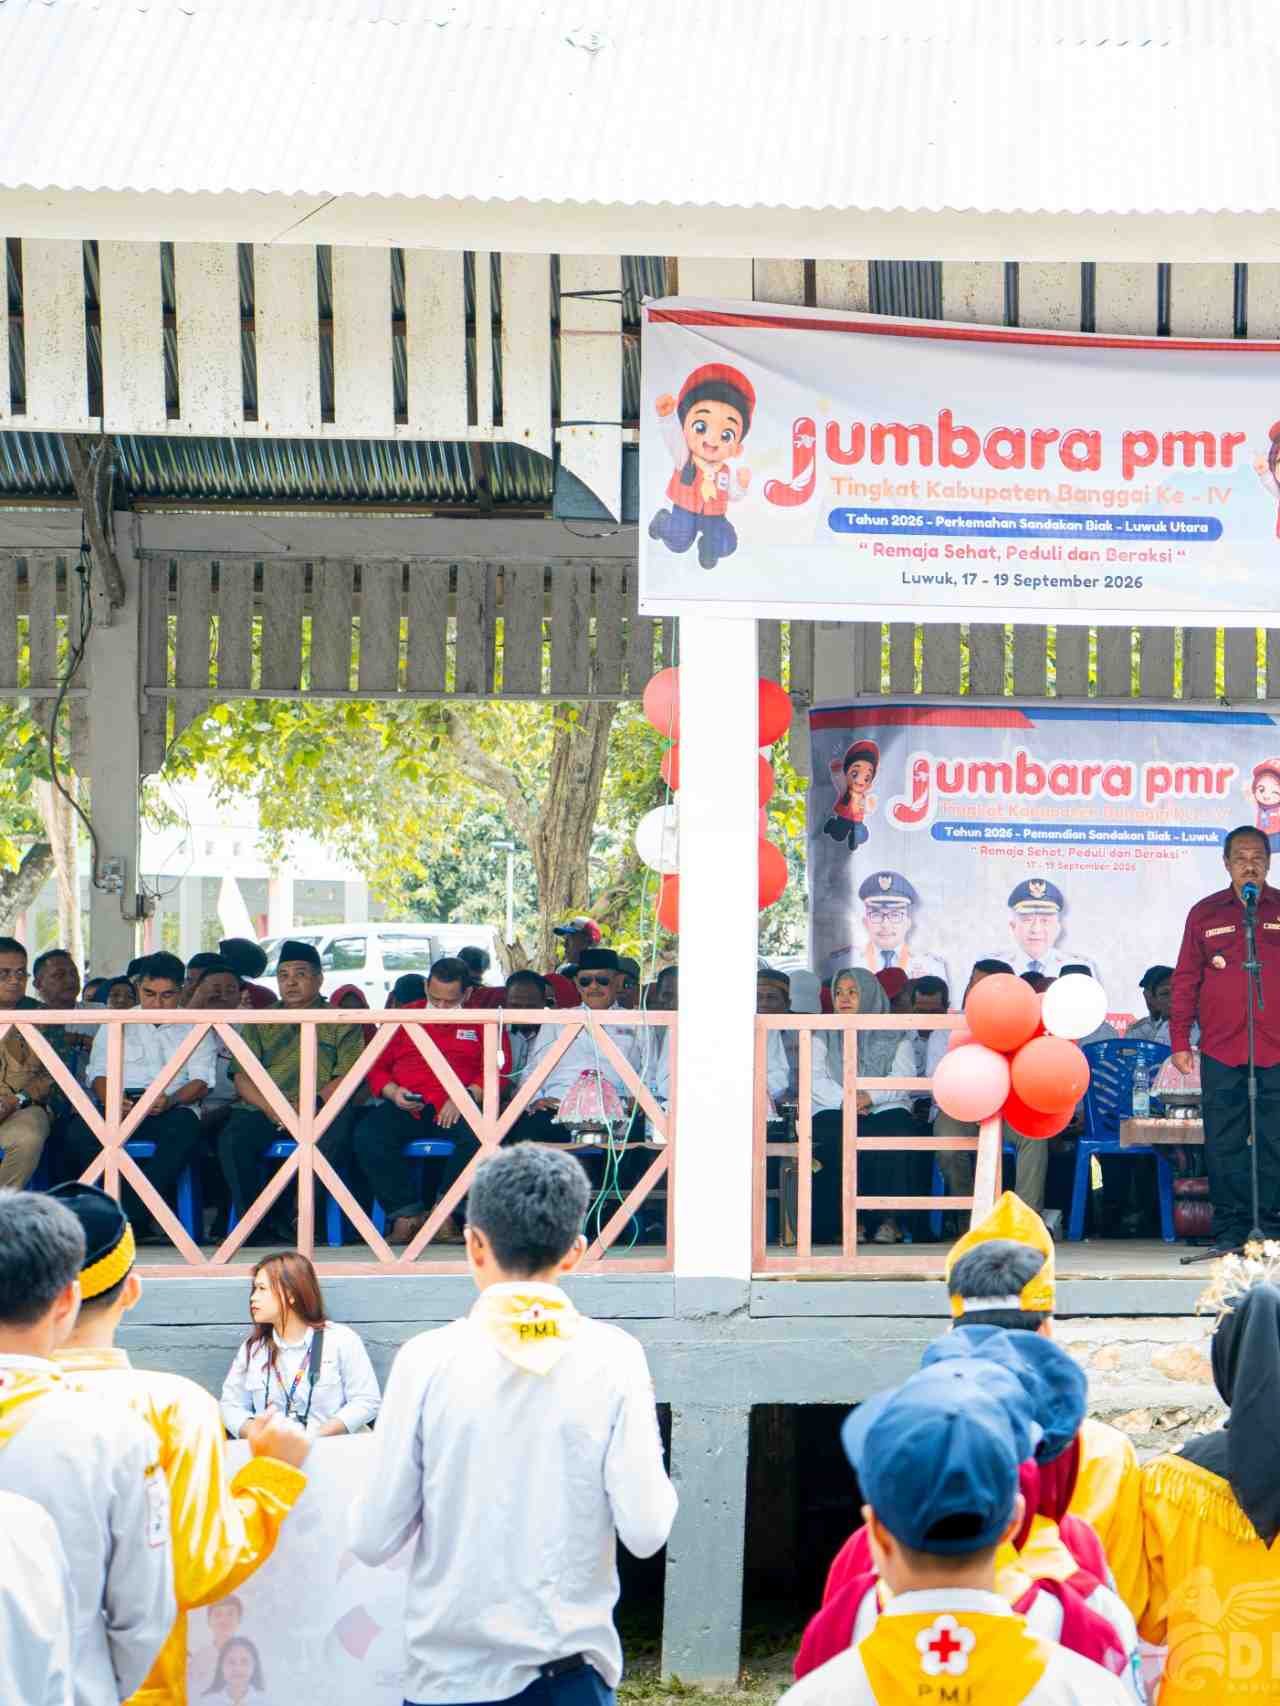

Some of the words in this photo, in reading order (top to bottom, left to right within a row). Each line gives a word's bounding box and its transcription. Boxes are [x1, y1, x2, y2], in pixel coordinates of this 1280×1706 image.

[1121, 430, 1247, 481] pmr
[831, 476, 920, 501] Tingkat
[927, 479, 1050, 503] Kabupaten
[1057, 484, 1150, 509] Banggai
[1157, 486, 1185, 504] Ke
[1208, 486, 1233, 505] IV
[846, 513, 888, 527] Tahun
[891, 515, 924, 528] 2026
[936, 516, 1017, 529] Perkemahan
[1019, 518, 1083, 532] Sandakan
[1086, 519, 1114, 532] Biak
[1125, 521, 1168, 533] Luwuk
[1170, 521, 1209, 533] Utara
[873, 542, 940, 562] Remaja
[944, 543, 1002, 562] Sehat,
[1006, 544, 1063, 562] Peduli
[1068, 546, 1100, 562] dan
[1106, 547, 1173, 563] Beraksi
[902, 571, 957, 587] Luwuk,
[962, 573, 978, 586] 17
[994, 574, 1009, 587] 19
[1014, 574, 1100, 591] September
[1104, 575, 1144, 589] 2026
[1146, 766, 1234, 802] pmr
[943, 825, 982, 839] Tahun
[984, 828, 1013, 839] 2026
[1088, 829, 1146, 842] Sandakan
[1182, 831, 1219, 843] Luwuk
[519, 1320, 557, 1338] PMI
[917, 1683, 972, 1704] PMI
